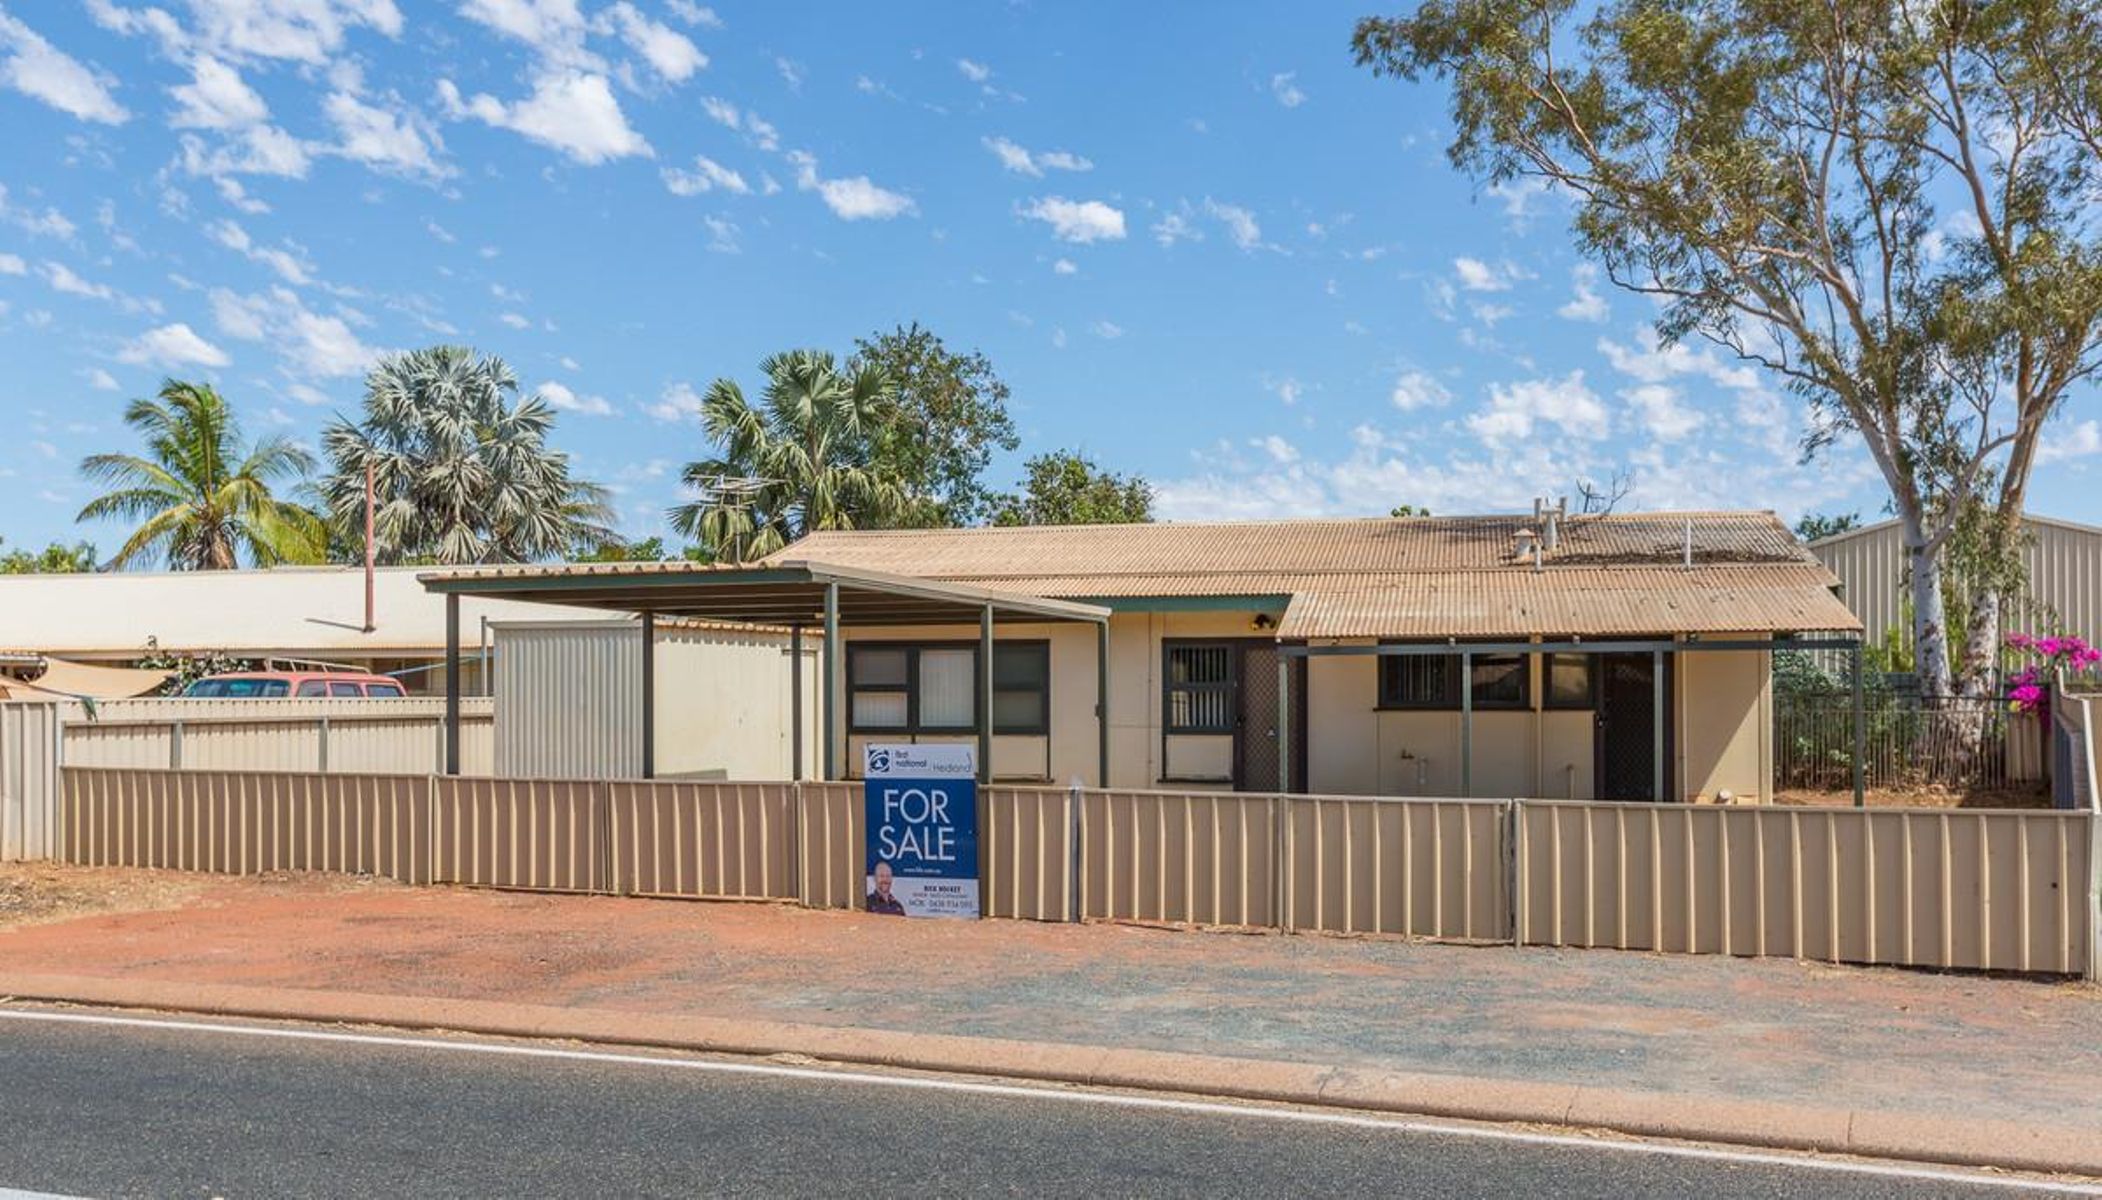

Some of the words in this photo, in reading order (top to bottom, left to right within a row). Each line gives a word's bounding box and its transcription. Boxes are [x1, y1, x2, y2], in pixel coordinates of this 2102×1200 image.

[895, 759, 927, 768] national
[932, 753, 973, 773] Hedland
[883, 788, 951, 824] FOR
[878, 825, 956, 861] SALE
